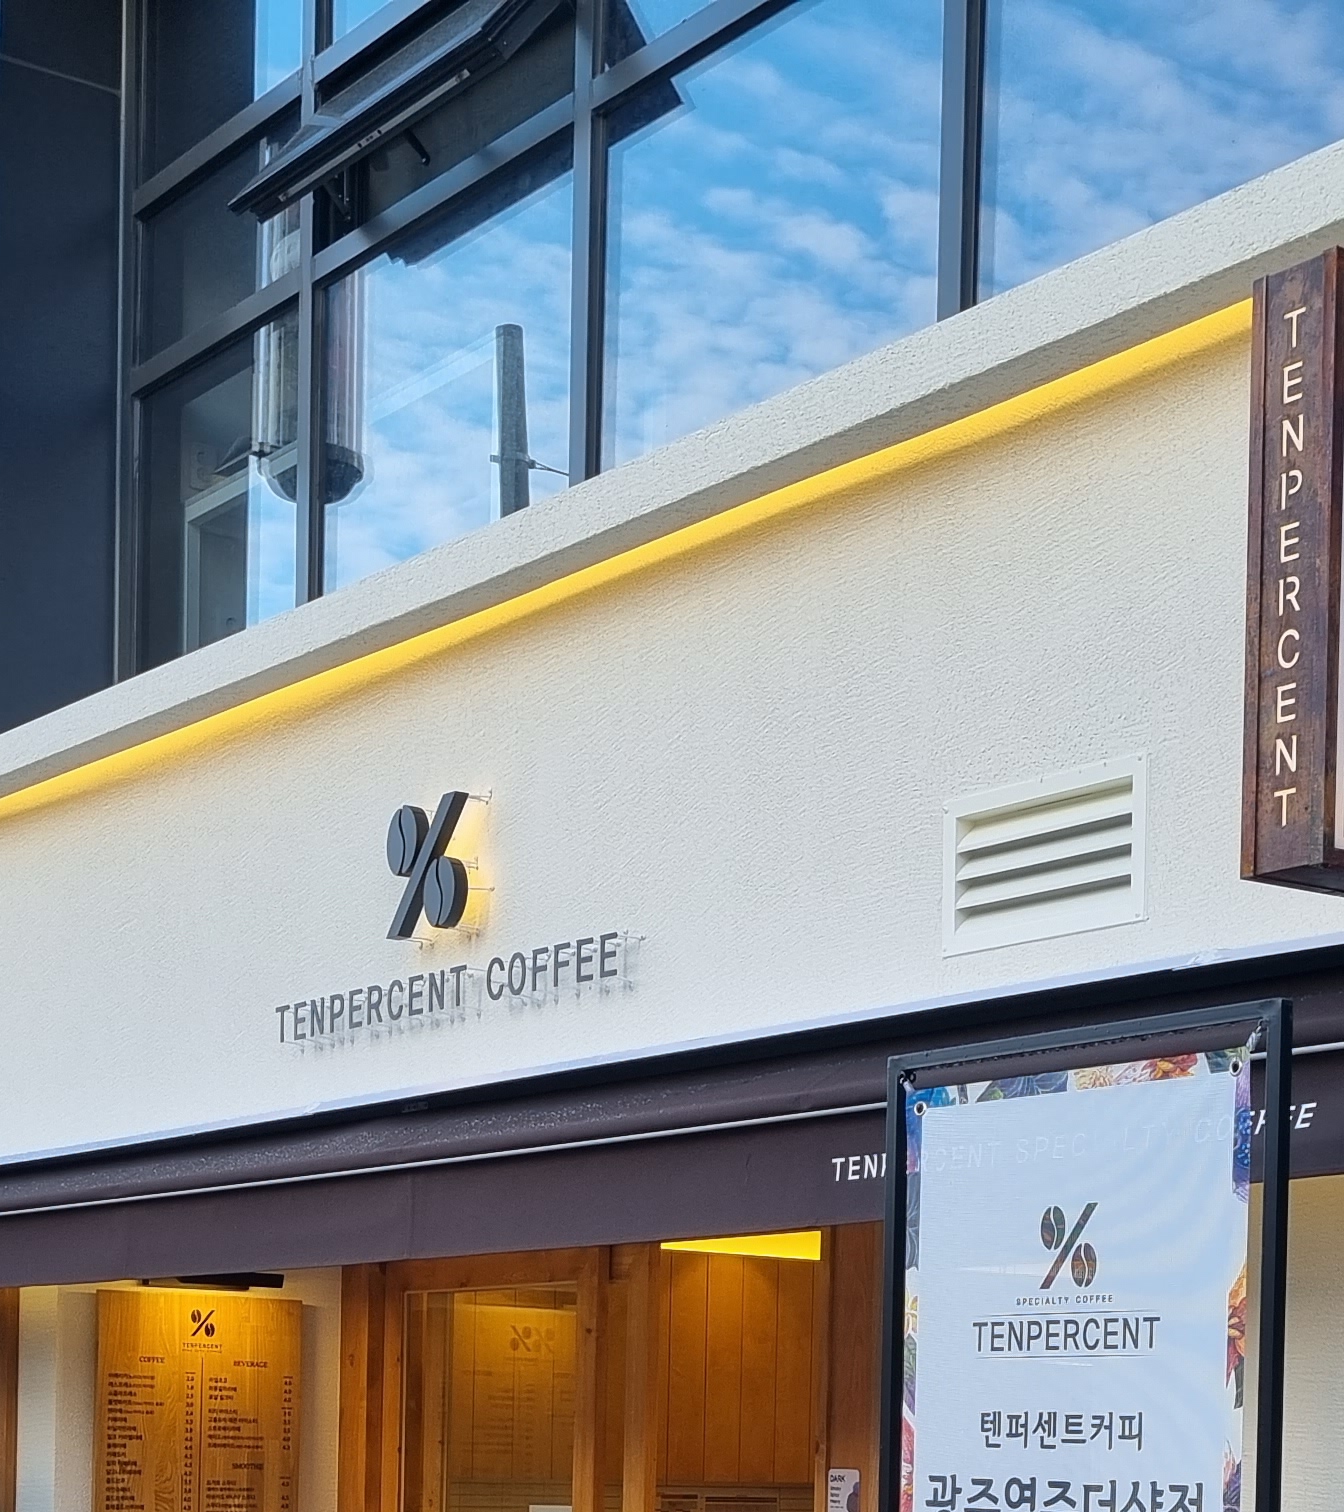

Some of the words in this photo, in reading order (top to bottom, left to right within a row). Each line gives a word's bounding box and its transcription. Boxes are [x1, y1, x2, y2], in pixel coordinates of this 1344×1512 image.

[1272, 306, 1306, 828] TENPERCENT
[274, 963, 468, 1043] TENPERCENT
[486, 931, 618, 1001] COFFEE
[1015, 1294, 1070, 1308] SPECIALTY
[1074, 1293, 1114, 1306] COFFEE
[972, 1315, 1161, 1353] TENPERCENT
[979, 1409, 1145, 1452] 텐퍼센트커피
[830, 1474, 846, 1483] DARK
